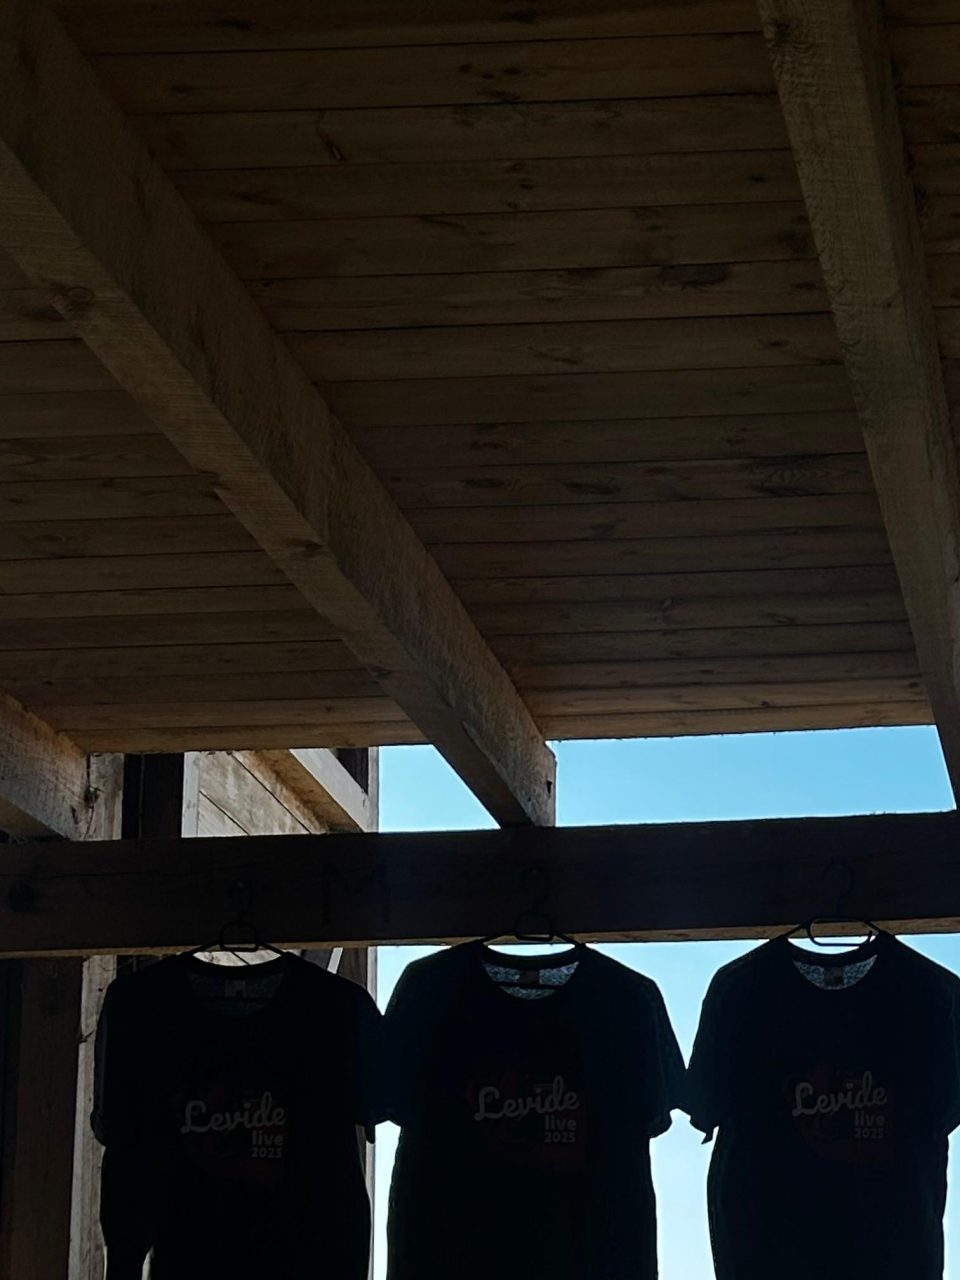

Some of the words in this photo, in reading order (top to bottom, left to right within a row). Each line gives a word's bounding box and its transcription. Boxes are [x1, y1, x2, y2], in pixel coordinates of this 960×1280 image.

[474, 1075, 580, 1121] Levide
[791, 1070, 888, 1117] Levide
[180, 1091, 287, 1135] Levide
[544, 1114, 577, 1131] live
[854, 1110, 885, 1127] live
[252, 1129, 284, 1147] live
